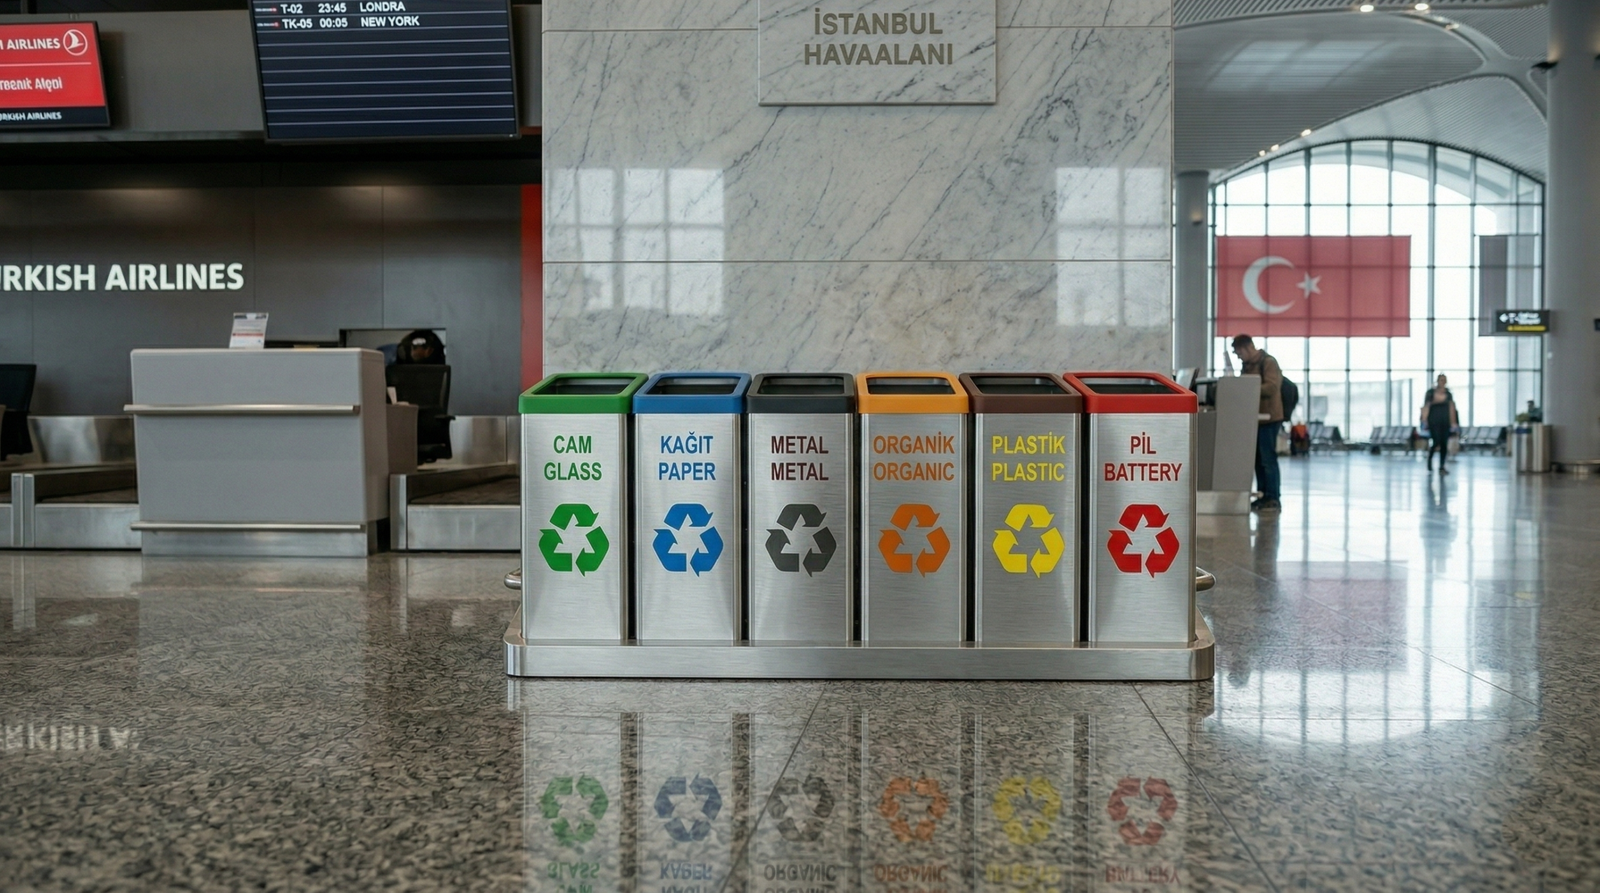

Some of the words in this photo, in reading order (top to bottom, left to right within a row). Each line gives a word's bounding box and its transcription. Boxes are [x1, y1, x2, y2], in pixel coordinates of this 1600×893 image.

[280, 4, 303, 14] T-02
[318, 3, 347, 13] 23:45
[360, 2, 406, 12] LONDRA
[282, 19, 313, 29] TK-05
[319, 18, 348, 28] 00:05
[361, 17, 386, 27] NEW
[388, 16, 420, 26] YORK
[814, 8, 943, 35] İSTANBUL
[7, 38, 61, 50] AIRLINES
[804, 43, 953, 65] HAVAALANI
[27, 111, 62, 120] AIRLINES
[0, 264, 96, 292] RKISH
[104, 263, 244, 291] AIRLINES
[553, 435, 592, 454] CAM
[660, 431, 714, 455] KAĞIT
[771, 435, 830, 454] METAL
[873, 431, 955, 454] ORGANİK
[991, 431, 1066, 454] PLASTİK
[1130, 431, 1157, 455] PİL
[543, 462, 603, 481] GLASS
[658, 462, 717, 481] PAPER
[771, 462, 830, 481] METAL
[873, 462, 954, 481] ORGANIC
[991, 462, 1065, 481] PLASTIC
[1104, 462, 1183, 481] BATTERY
